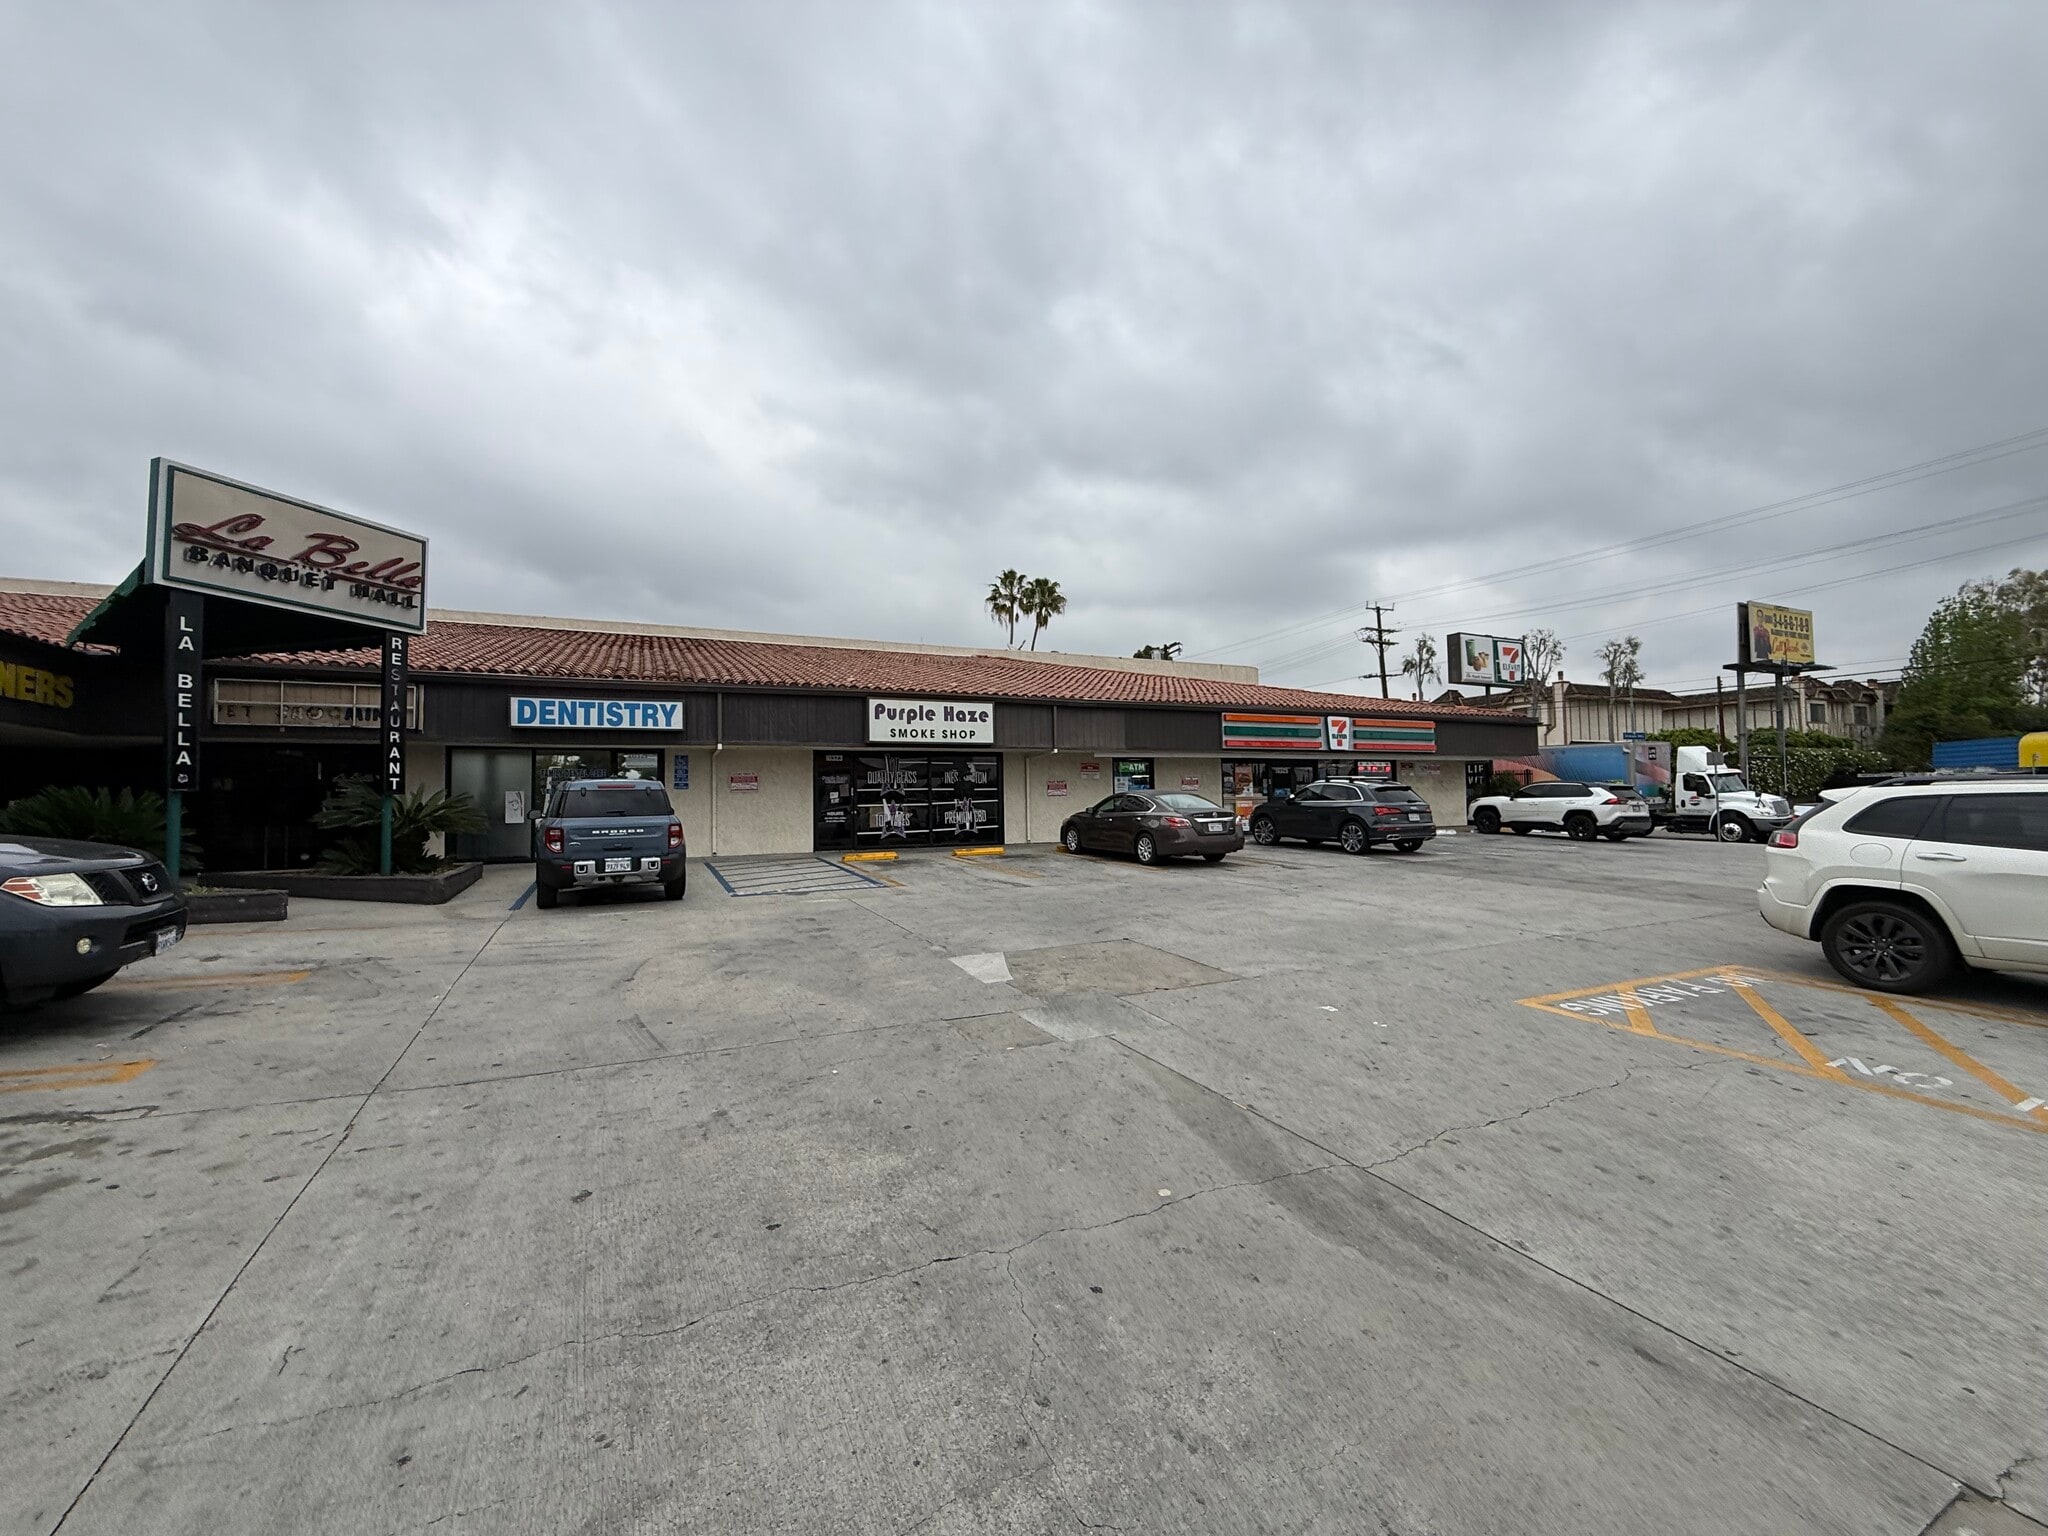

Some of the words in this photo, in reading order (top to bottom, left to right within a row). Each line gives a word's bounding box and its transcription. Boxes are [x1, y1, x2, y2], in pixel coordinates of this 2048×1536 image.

[173, 513, 275, 551] La
[289, 531, 423, 589] Bella
[182, 545, 340, 592] BANQUET
[350, 582, 419, 610] HALL
[178, 616, 194, 651] LA
[175, 673, 194, 766] BELLA
[388, 637, 403, 791] RESTAURANT
[517, 699, 677, 728] DENTISTRY
[874, 703, 936, 725] Purple
[943, 705, 989, 723] Haze
[889, 728, 936, 739] SMOKE
[941, 729, 976, 739] SHOP
[1129, 763, 1145, 772] ATM
